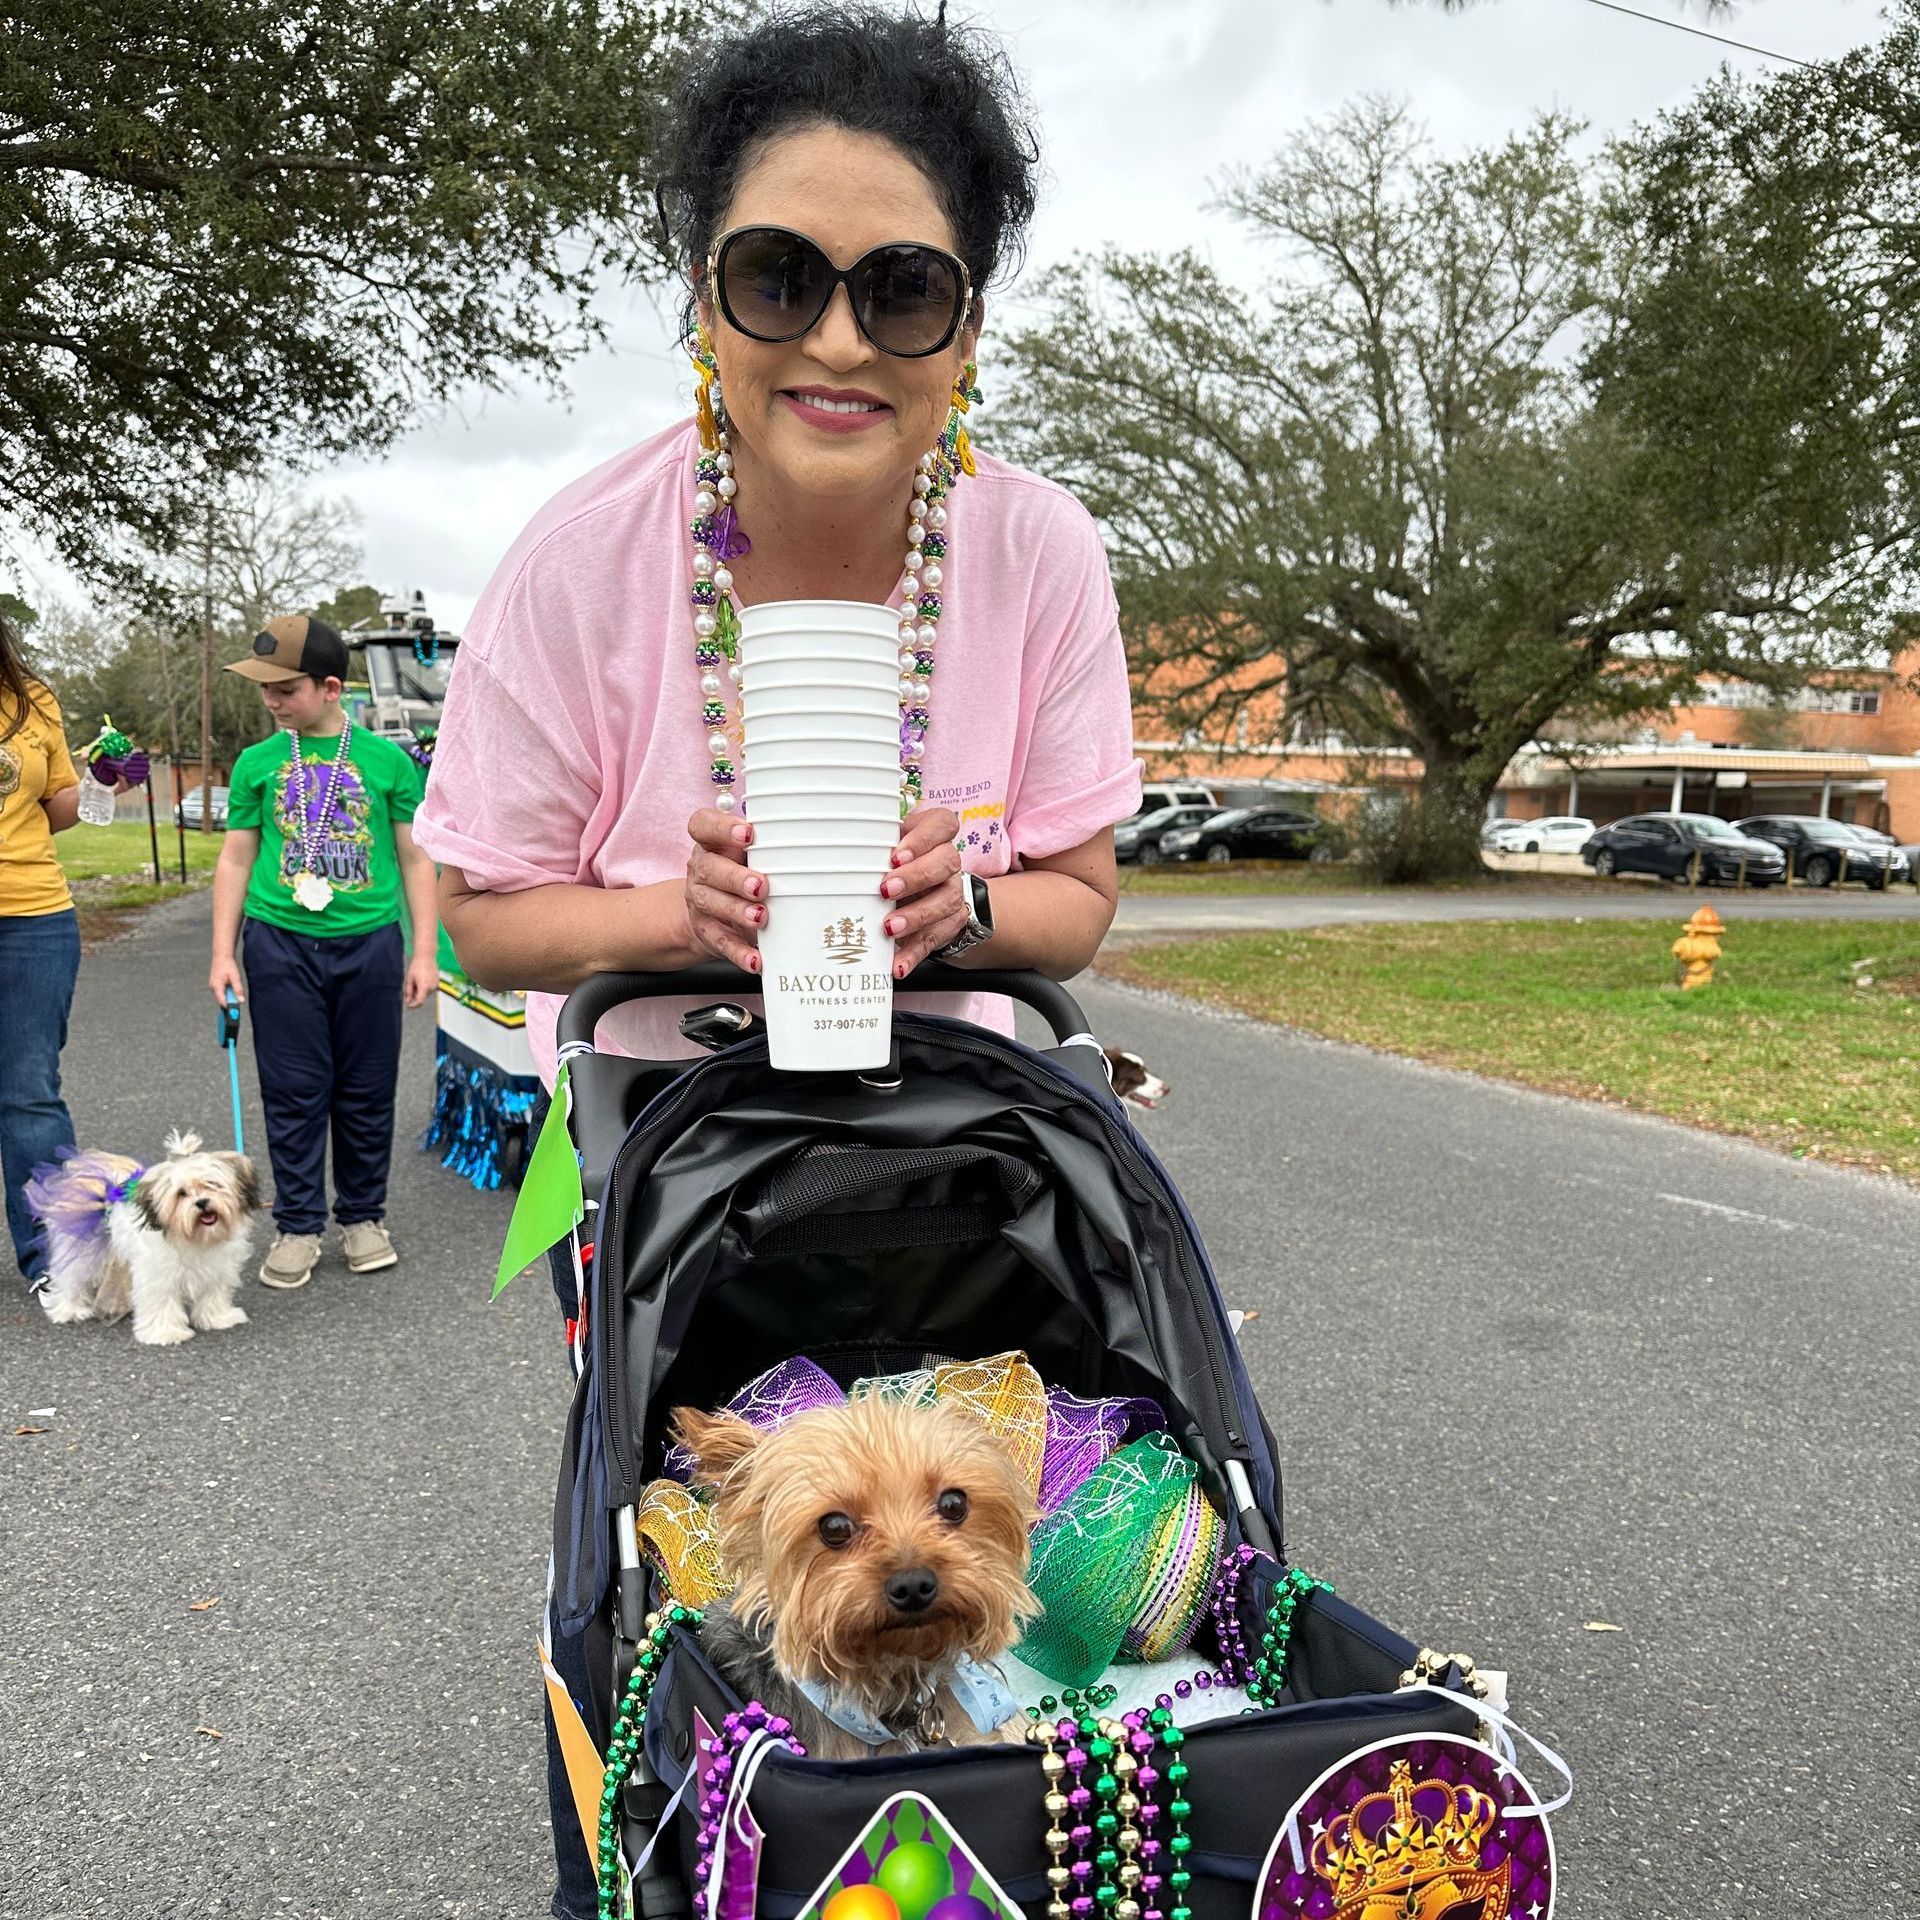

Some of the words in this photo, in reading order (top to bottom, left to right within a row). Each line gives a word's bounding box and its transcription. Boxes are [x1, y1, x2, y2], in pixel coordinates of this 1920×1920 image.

[928, 787, 962, 799] BAYOU
[966, 780, 991, 795] BEND
[779, 974, 851, 992] BAYOU
[800, 997, 848, 1005] FITNESS
[854, 996, 886, 1004] CENTER
[814, 1018, 879, 1030] 337-907-6767
